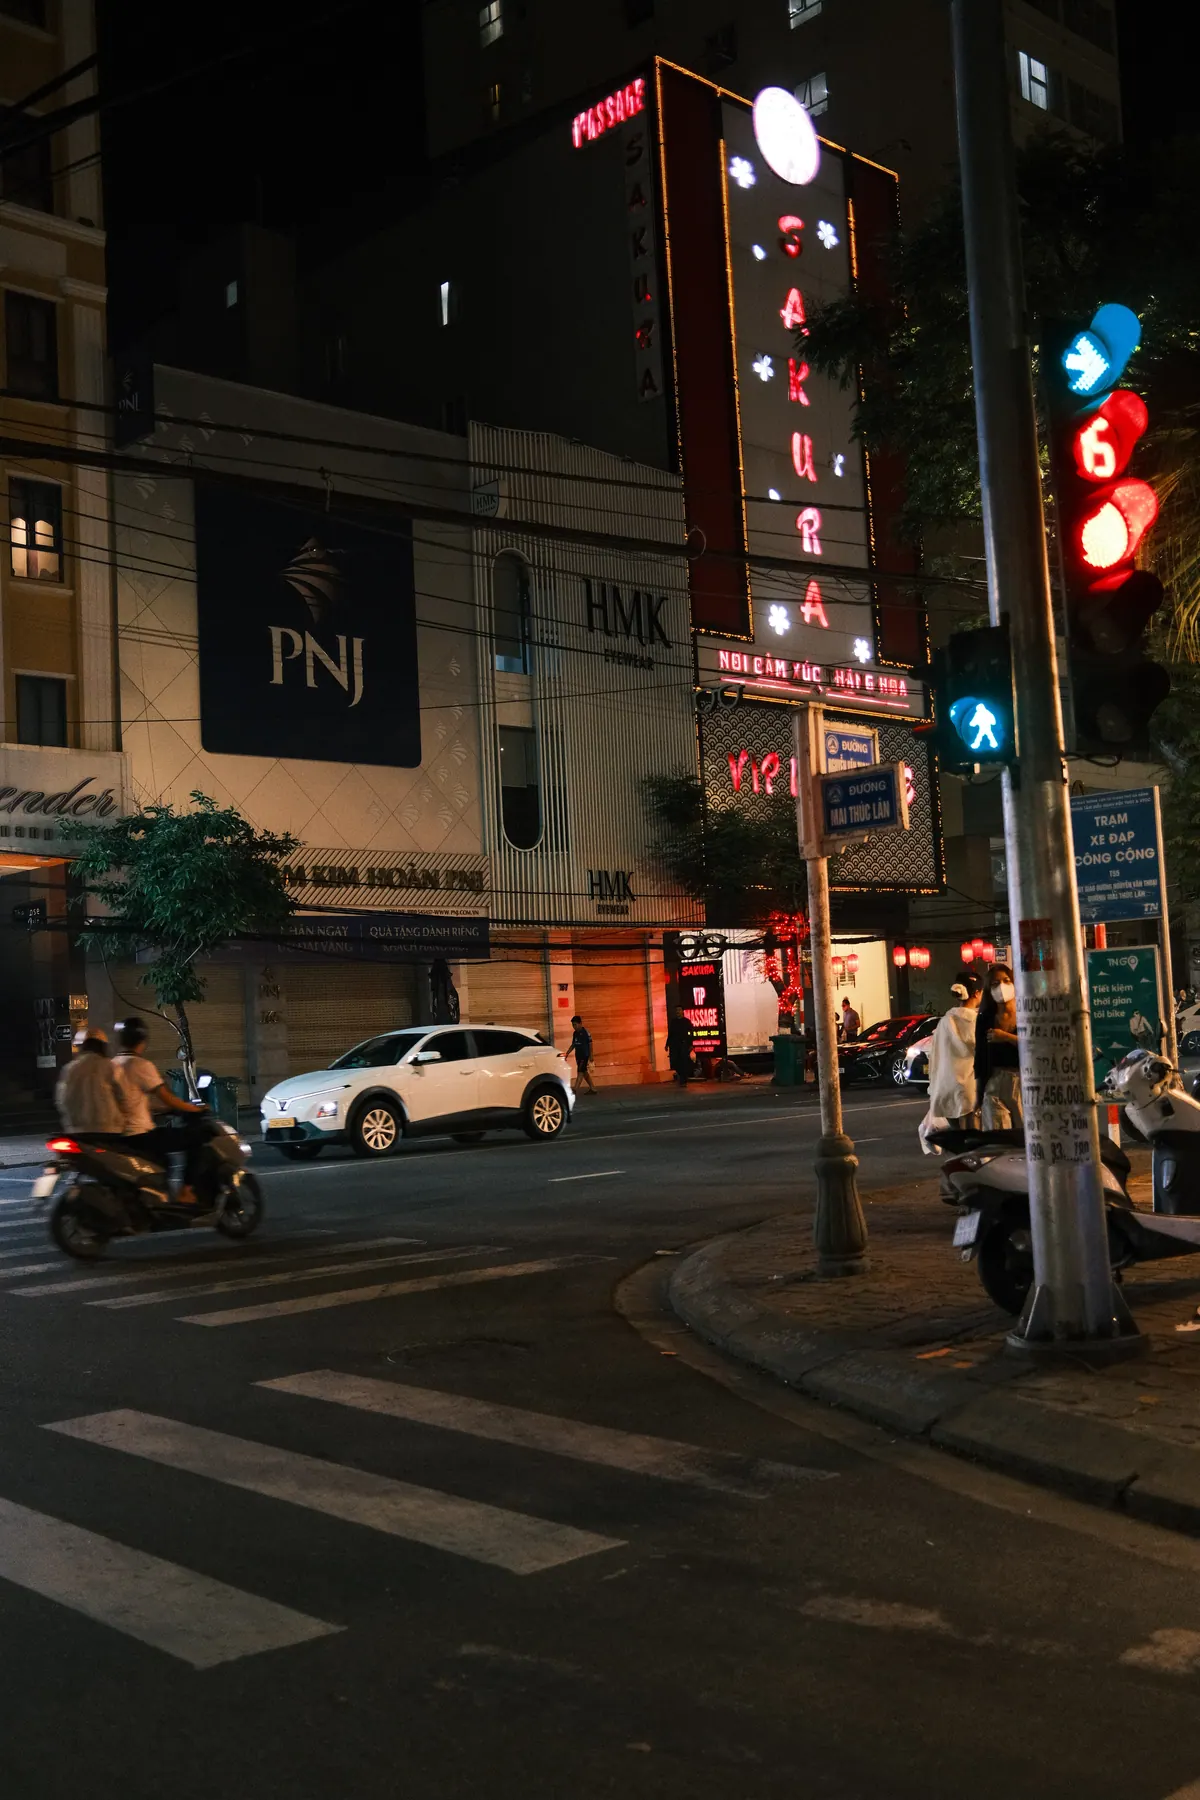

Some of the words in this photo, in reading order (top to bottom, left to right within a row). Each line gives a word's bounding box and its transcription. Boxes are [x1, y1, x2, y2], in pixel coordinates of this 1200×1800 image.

[777, 214, 829, 630] SAKURA
[1081, 416, 1116, 478] 6
[583, 578, 673, 649] HMK
[267, 625, 365, 708] PNJ
[878, 677, 909, 697] HOA
[841, 738, 868, 754] ĐƯỜNG
[727, 749, 780, 795] VIP
[849, 780, 887, 796] ĐƯỜNG
[830, 807, 847, 826] MAI
[849, 801, 871, 823] THÚC
[1094, 813, 1128, 829] TRẠM
[1090, 834, 1106, 846] XE
[1108, 831, 1136, 846] ĐẠP
[1075, 852, 1111, 867] CÔNG
[1115, 847, 1156, 864] CỘNG
[311, 865, 361, 889] KIM
[587, 869, 637, 902] HMK
[597, 904, 629, 915] EYEWEAR
[318, 925, 349, 937] NGAY
[369, 924, 393, 939] QUÀ
[681, 964, 715, 977] SAKURA
[692, 986, 707, 1006] VIP
[1112, 996, 1133, 1007] gian
[1106, 1009, 1127, 1018] bike
